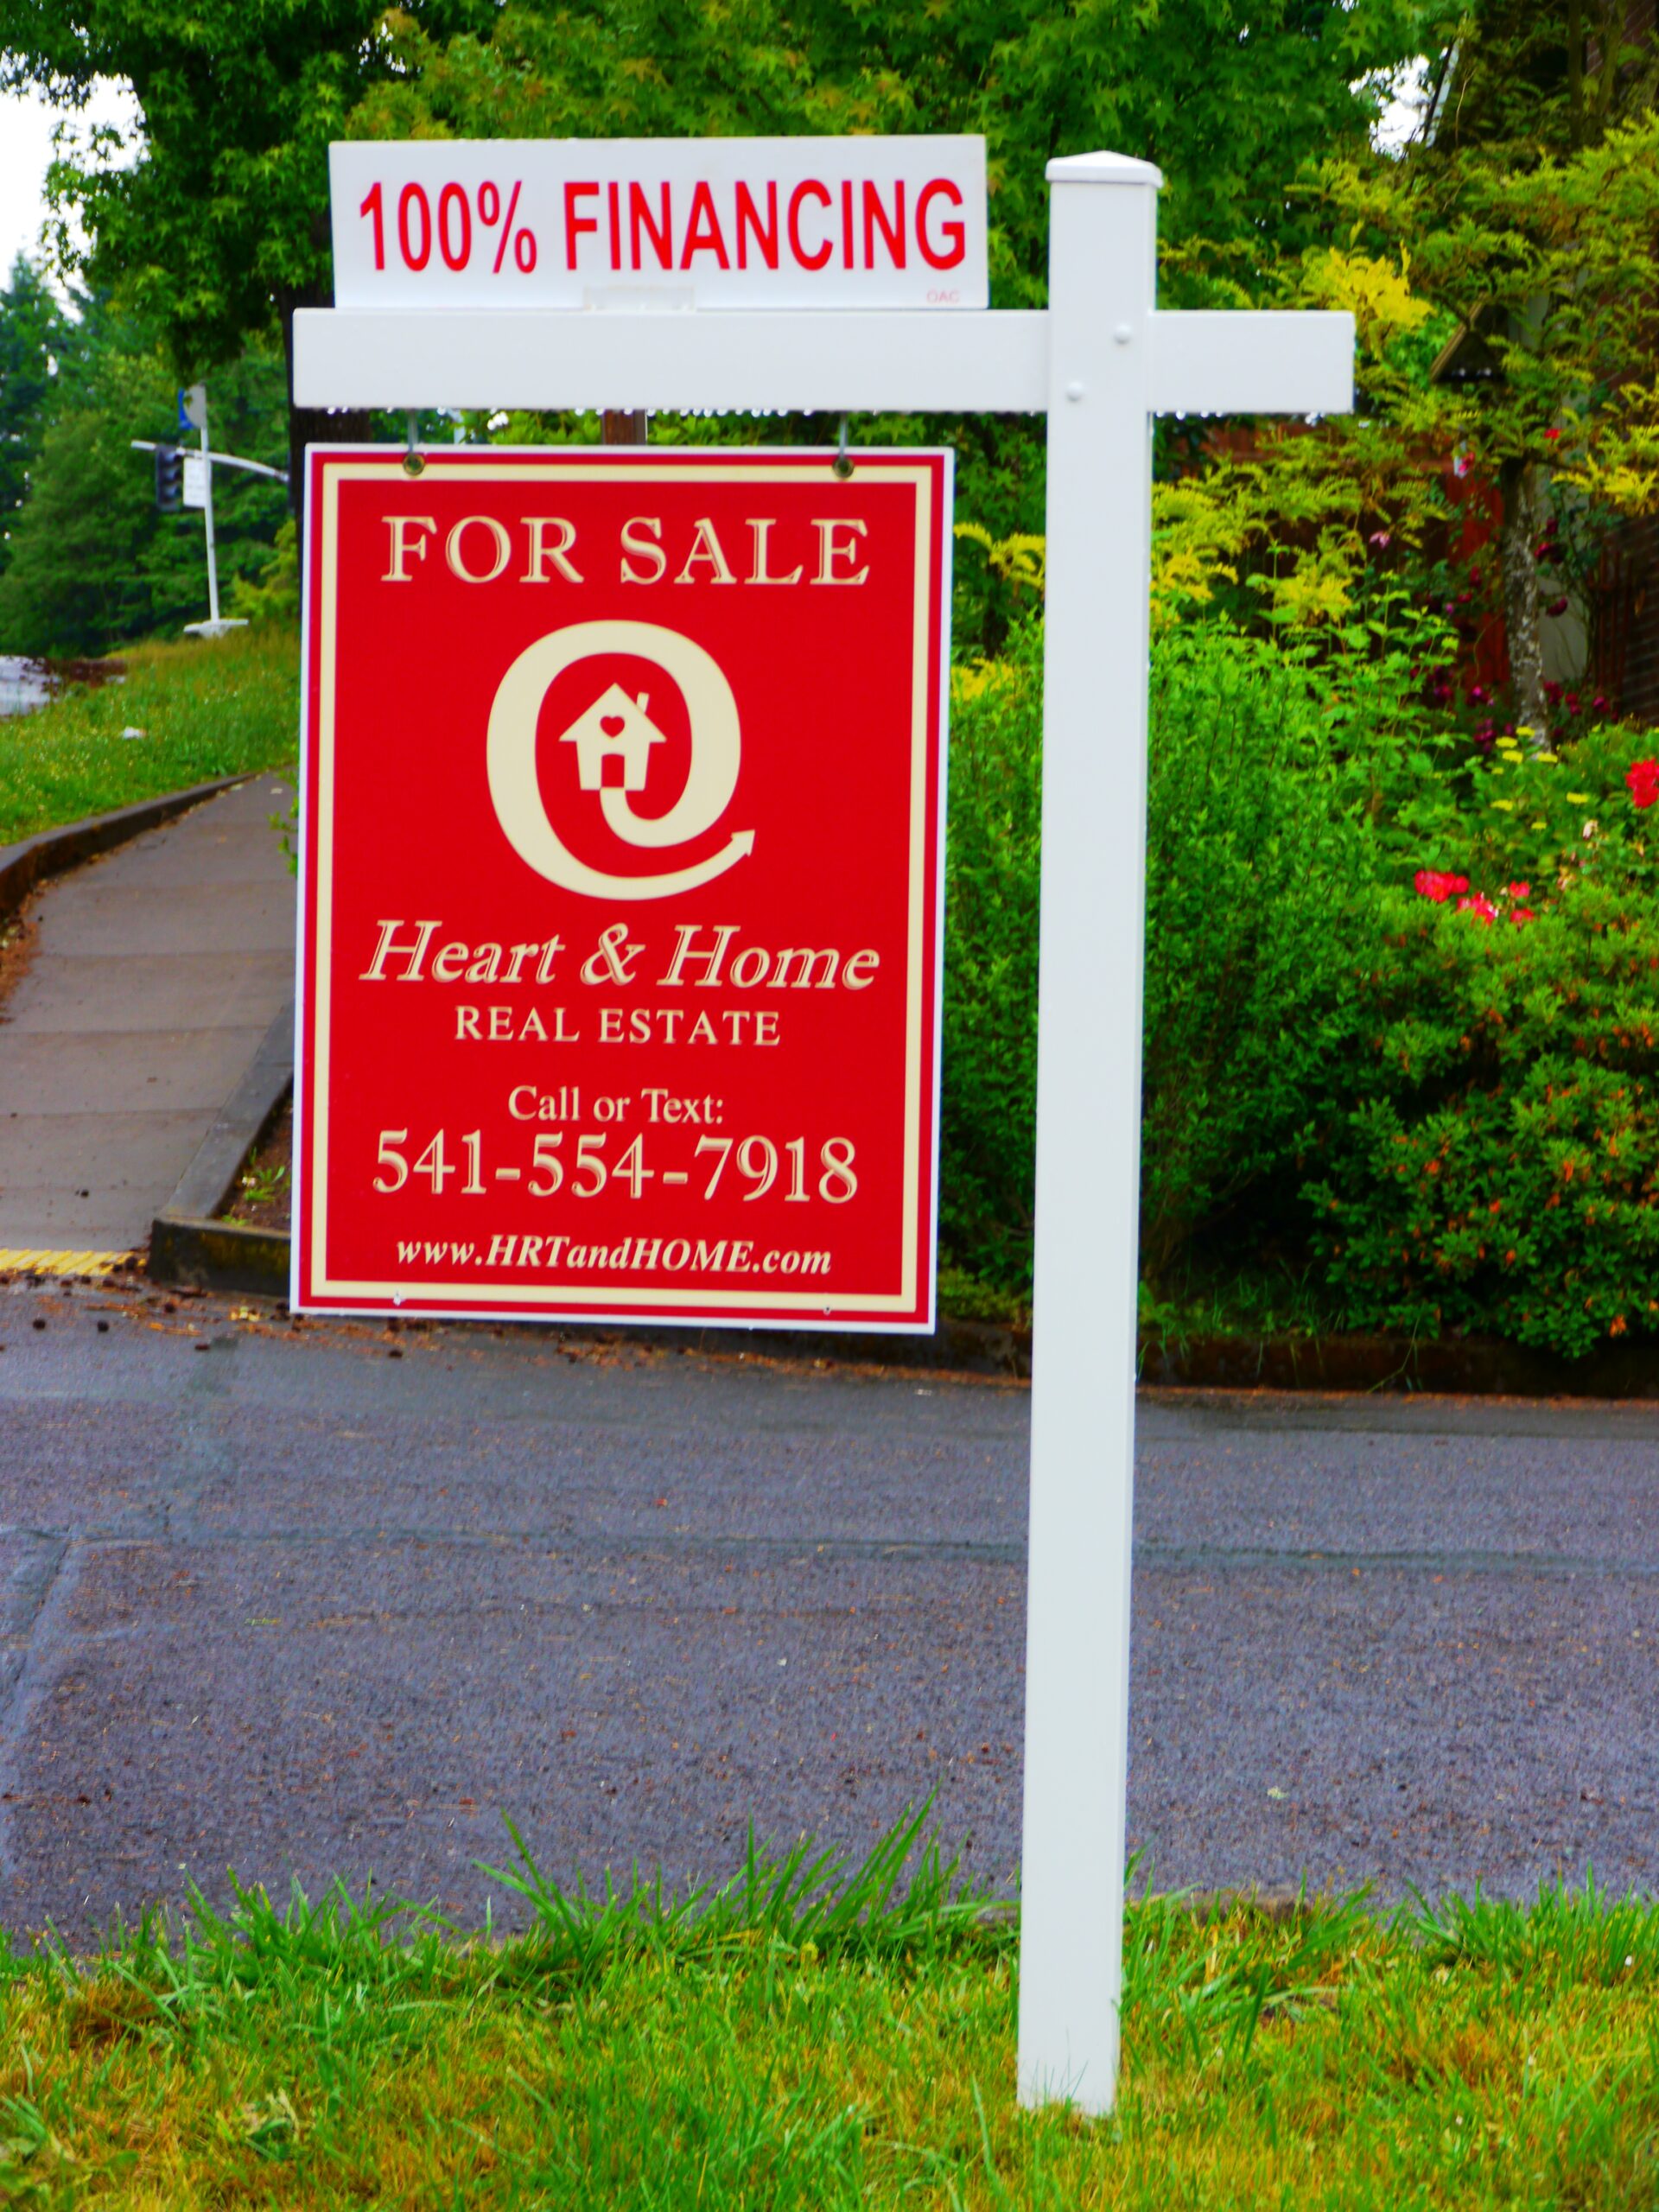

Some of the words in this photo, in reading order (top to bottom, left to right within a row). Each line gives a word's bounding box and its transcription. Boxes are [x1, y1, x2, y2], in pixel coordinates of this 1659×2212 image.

[359, 180, 537, 274] 100%
[563, 177, 966, 272] FINANCING
[381, 516, 585, 583] FOR
[620, 517, 870, 585] SALE
[359, 919, 565, 984] Heart
[580, 922, 646, 985] &
[657, 925, 880, 989] Home
[454, 1006, 580, 1042] REAL
[599, 1008, 781, 1046] ESTATE
[507, 1085, 580, 1121] Call
[593, 1097, 631, 1122] or
[640, 1088, 724, 1124] Text:
[372, 1128, 859, 1204] 541-554-7918
[397, 1234, 832, 1275] www.HRTandHOME.com
